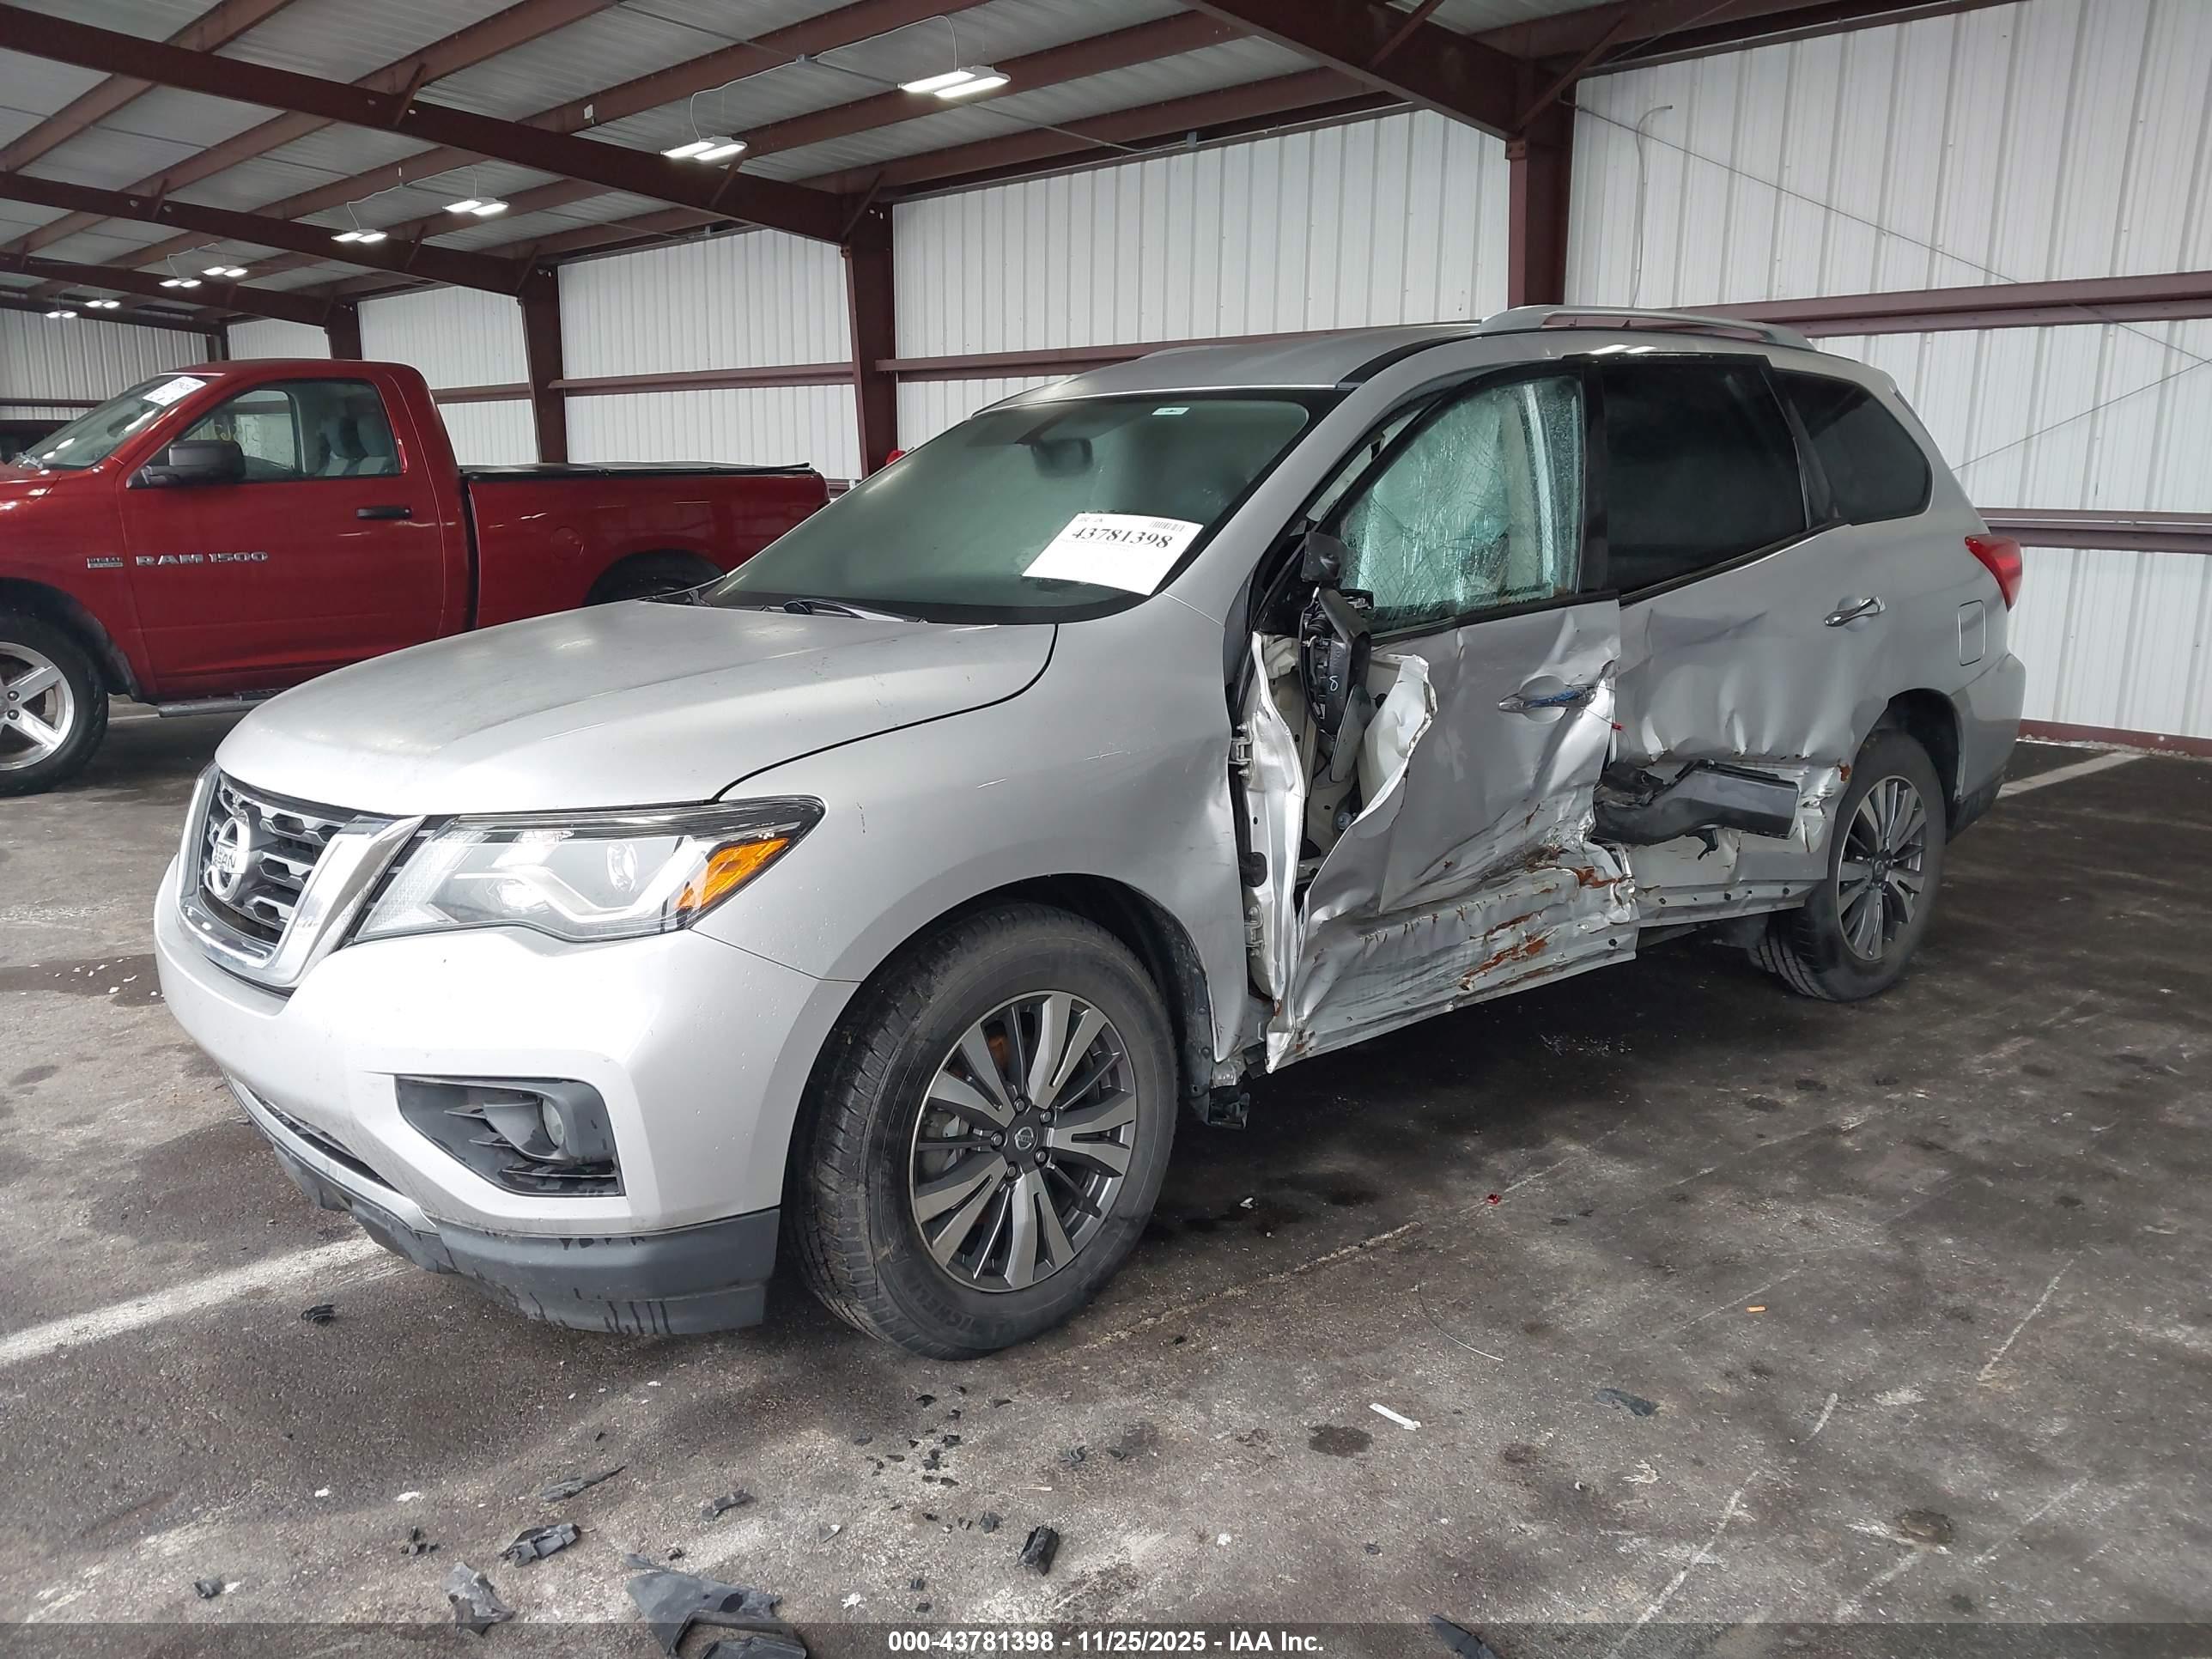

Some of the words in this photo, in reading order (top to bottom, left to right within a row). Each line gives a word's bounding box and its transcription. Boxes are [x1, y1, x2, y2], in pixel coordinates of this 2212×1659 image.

[1071, 526, 1174, 549] 43781398
[135, 554, 204, 567] RAM
[208, 551, 268, 565] 1500
